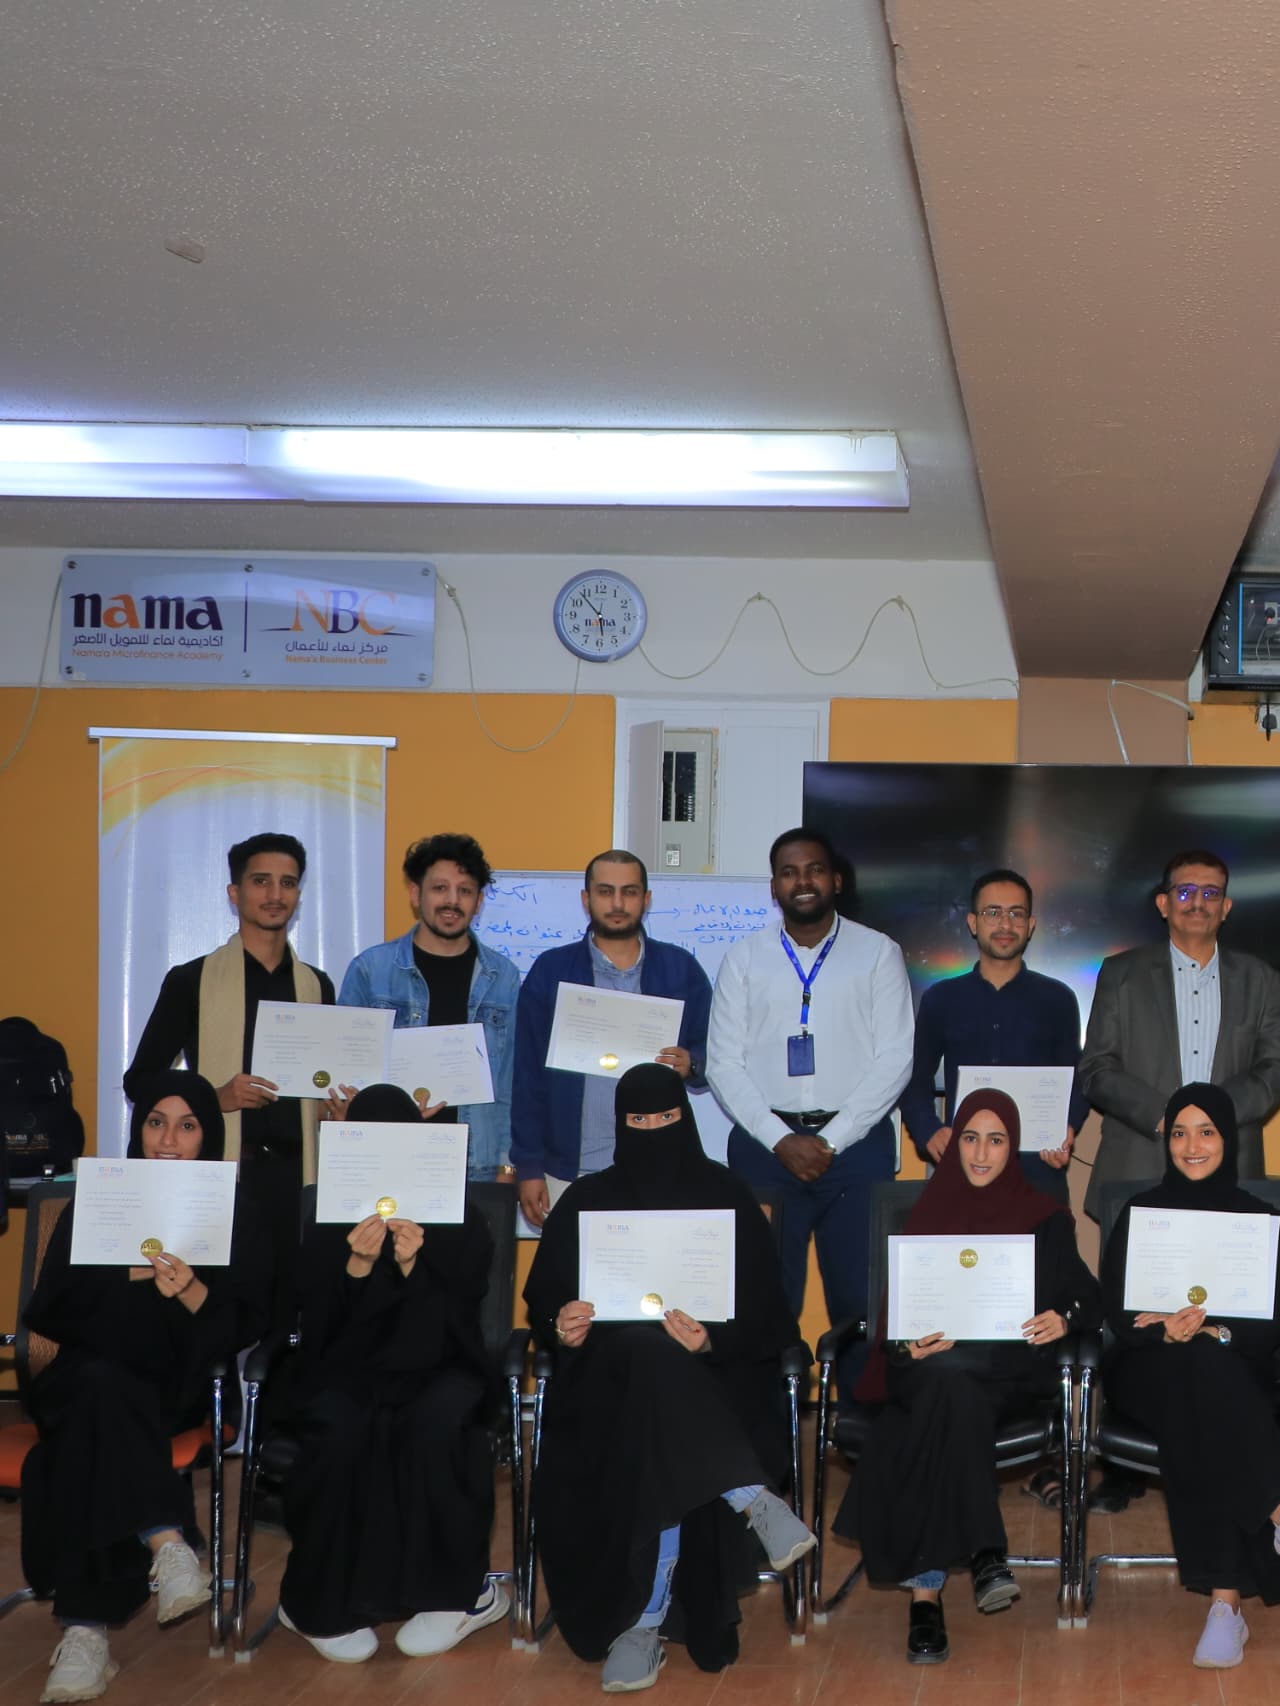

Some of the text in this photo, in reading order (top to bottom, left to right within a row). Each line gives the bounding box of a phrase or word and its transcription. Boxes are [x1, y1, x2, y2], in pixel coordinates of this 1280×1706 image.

[594, 584, 607, 594] 12
[613, 589, 617, 598] 1
[572, 599, 583, 608] 10
[620, 600, 628, 609] 2
[69, 593, 223, 631] nama
[290, 588, 396, 637] NBC
[569, 611, 577, 620] 9
[624, 612, 631, 621] 3
[572, 624, 580, 633] 8
[582, 634, 590, 644] 7
[595, 638, 603, 648] 6
[611, 635, 618, 645] 5
[332, 641, 355, 652] نماء
[359, 641, 388, 655] مركز
